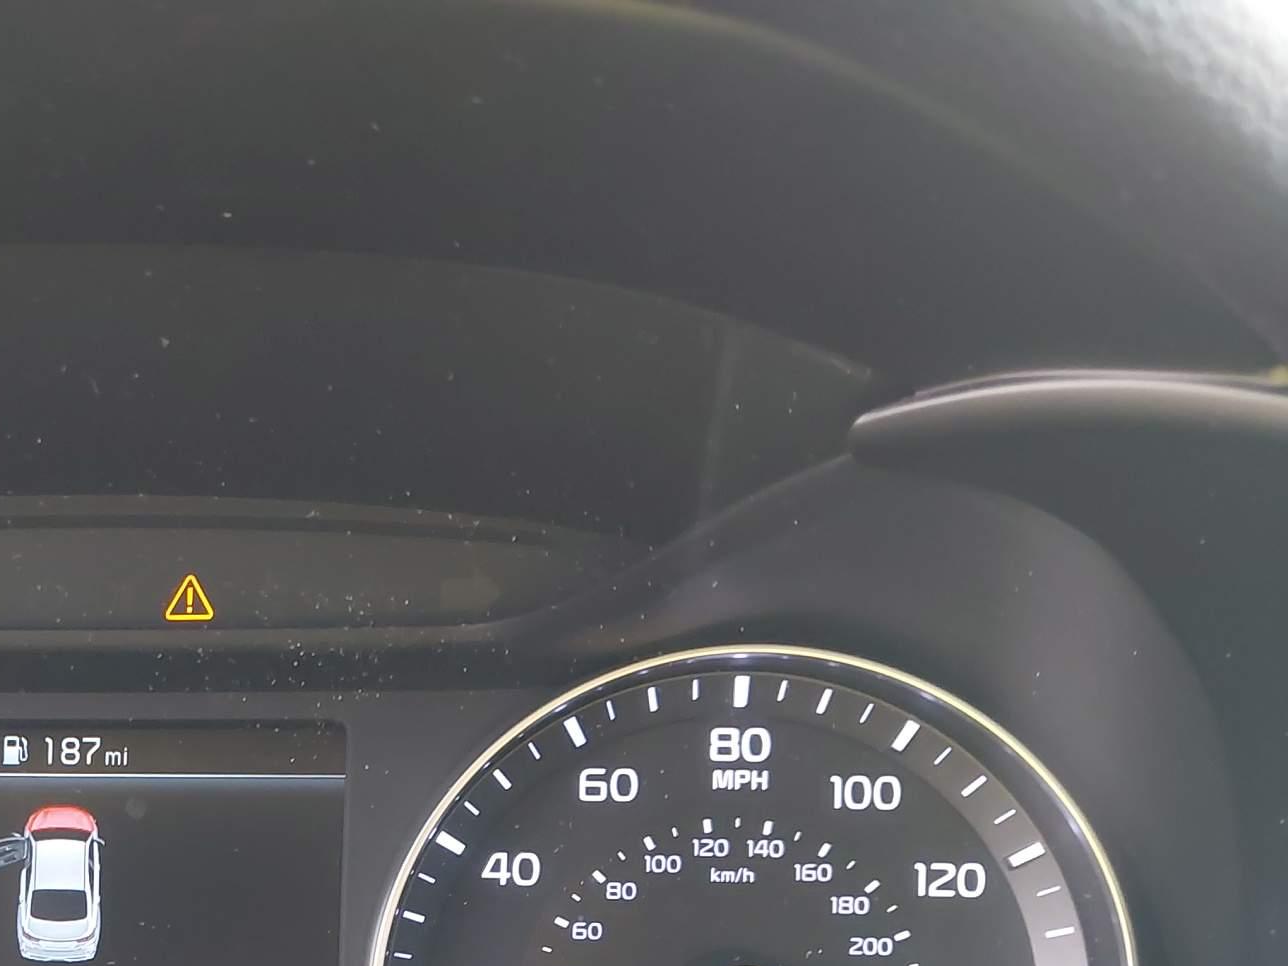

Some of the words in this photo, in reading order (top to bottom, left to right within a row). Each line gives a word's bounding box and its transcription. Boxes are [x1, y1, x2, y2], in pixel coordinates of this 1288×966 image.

[709, 727, 772, 764] 80
[578, 768, 639, 802] 60
[712, 769, 769, 791] MPH
[830, 775, 902, 811] 100
[692, 838, 729, 857] 120
[746, 839, 784, 858] 140
[481, 850, 541, 886] 40
[644, 854, 682, 874] 100
[794, 863, 832, 882] 160
[709, 866, 755, 884] km/h
[914, 862, 986, 899] 120
[606, 882, 637, 901] 80
[830, 896, 870, 915] 180
[571, 922, 603, 941] 60
[848, 936, 893, 957] 200
